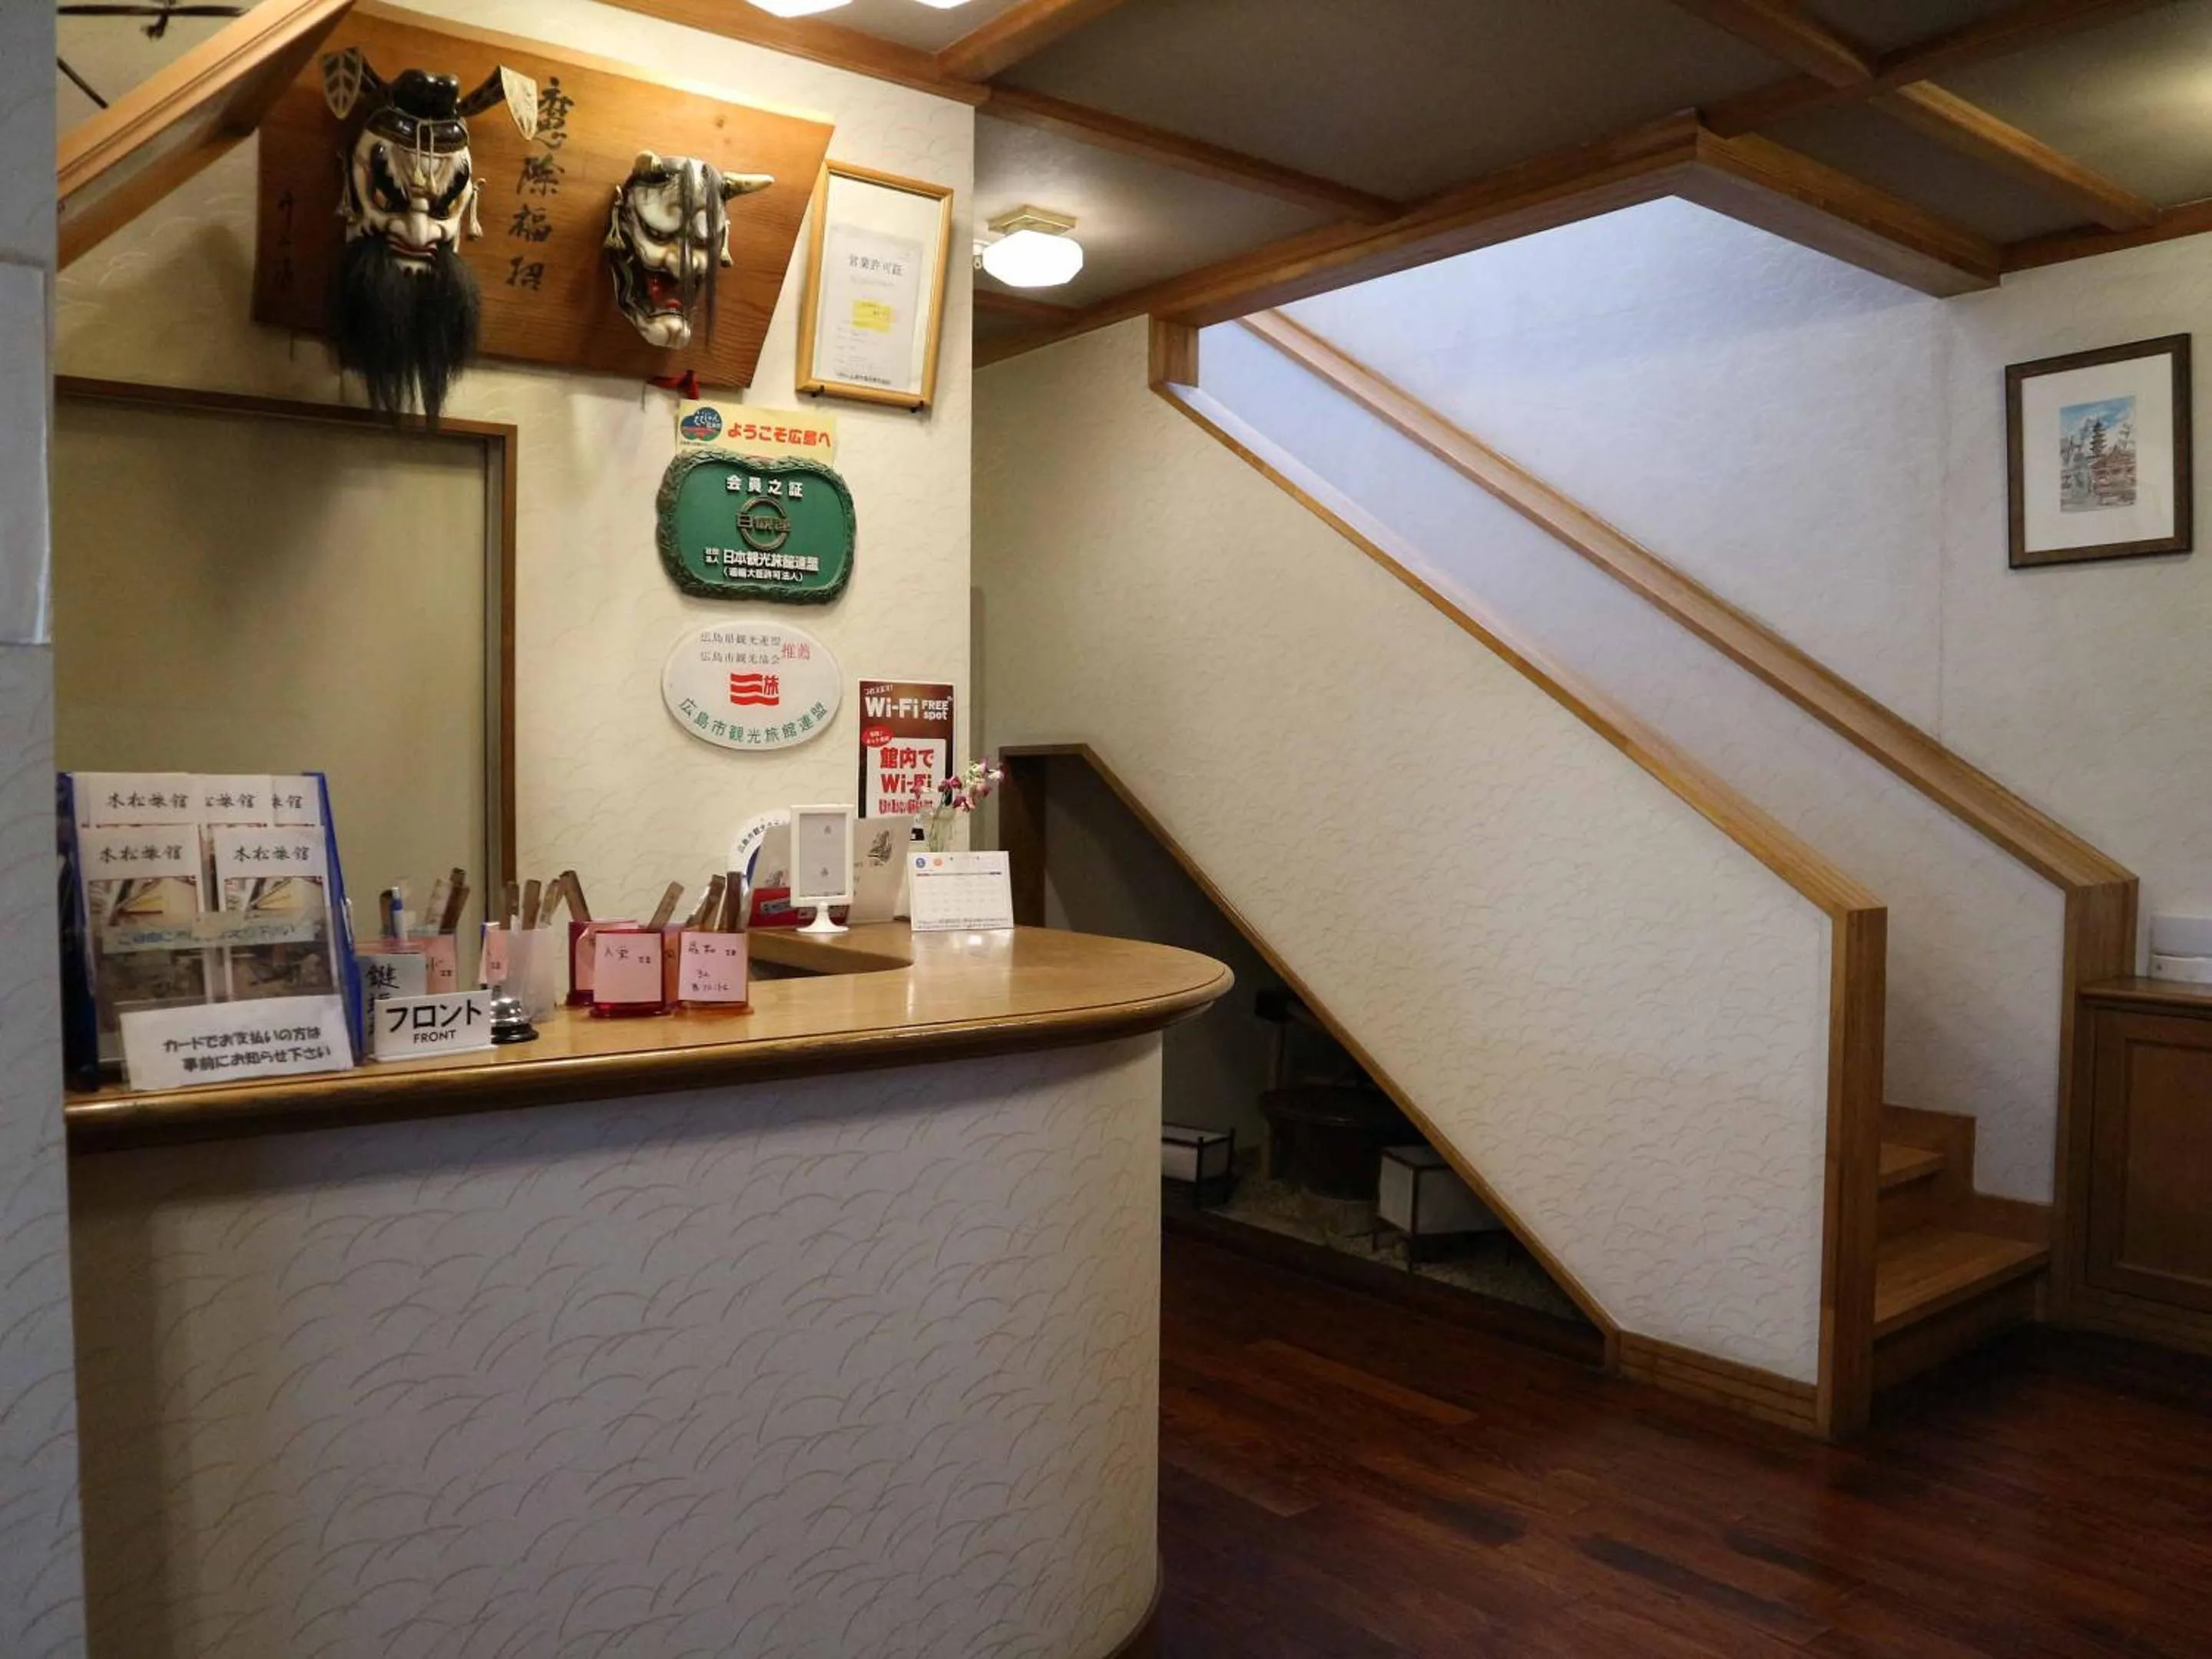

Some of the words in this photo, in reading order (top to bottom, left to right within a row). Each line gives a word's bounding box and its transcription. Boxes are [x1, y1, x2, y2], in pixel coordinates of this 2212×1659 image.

[727, 422, 831, 448] ようこそ広島へ
[725, 474, 803, 498] 会員之証
[865, 697, 919, 719] Wi-Fi
[922, 700, 949, 710] FREE
[923, 710, 948, 721] spot
[880, 747, 934, 768] 館内で
[880, 773, 932, 793] Wi-Fi
[386, 999, 482, 1032] フロント
[163, 1026, 320, 1052] カードでお支払いの方は
[412, 1029, 456, 1043] FRONT
[183, 1045, 331, 1072] 事前にお知らせ下さい
